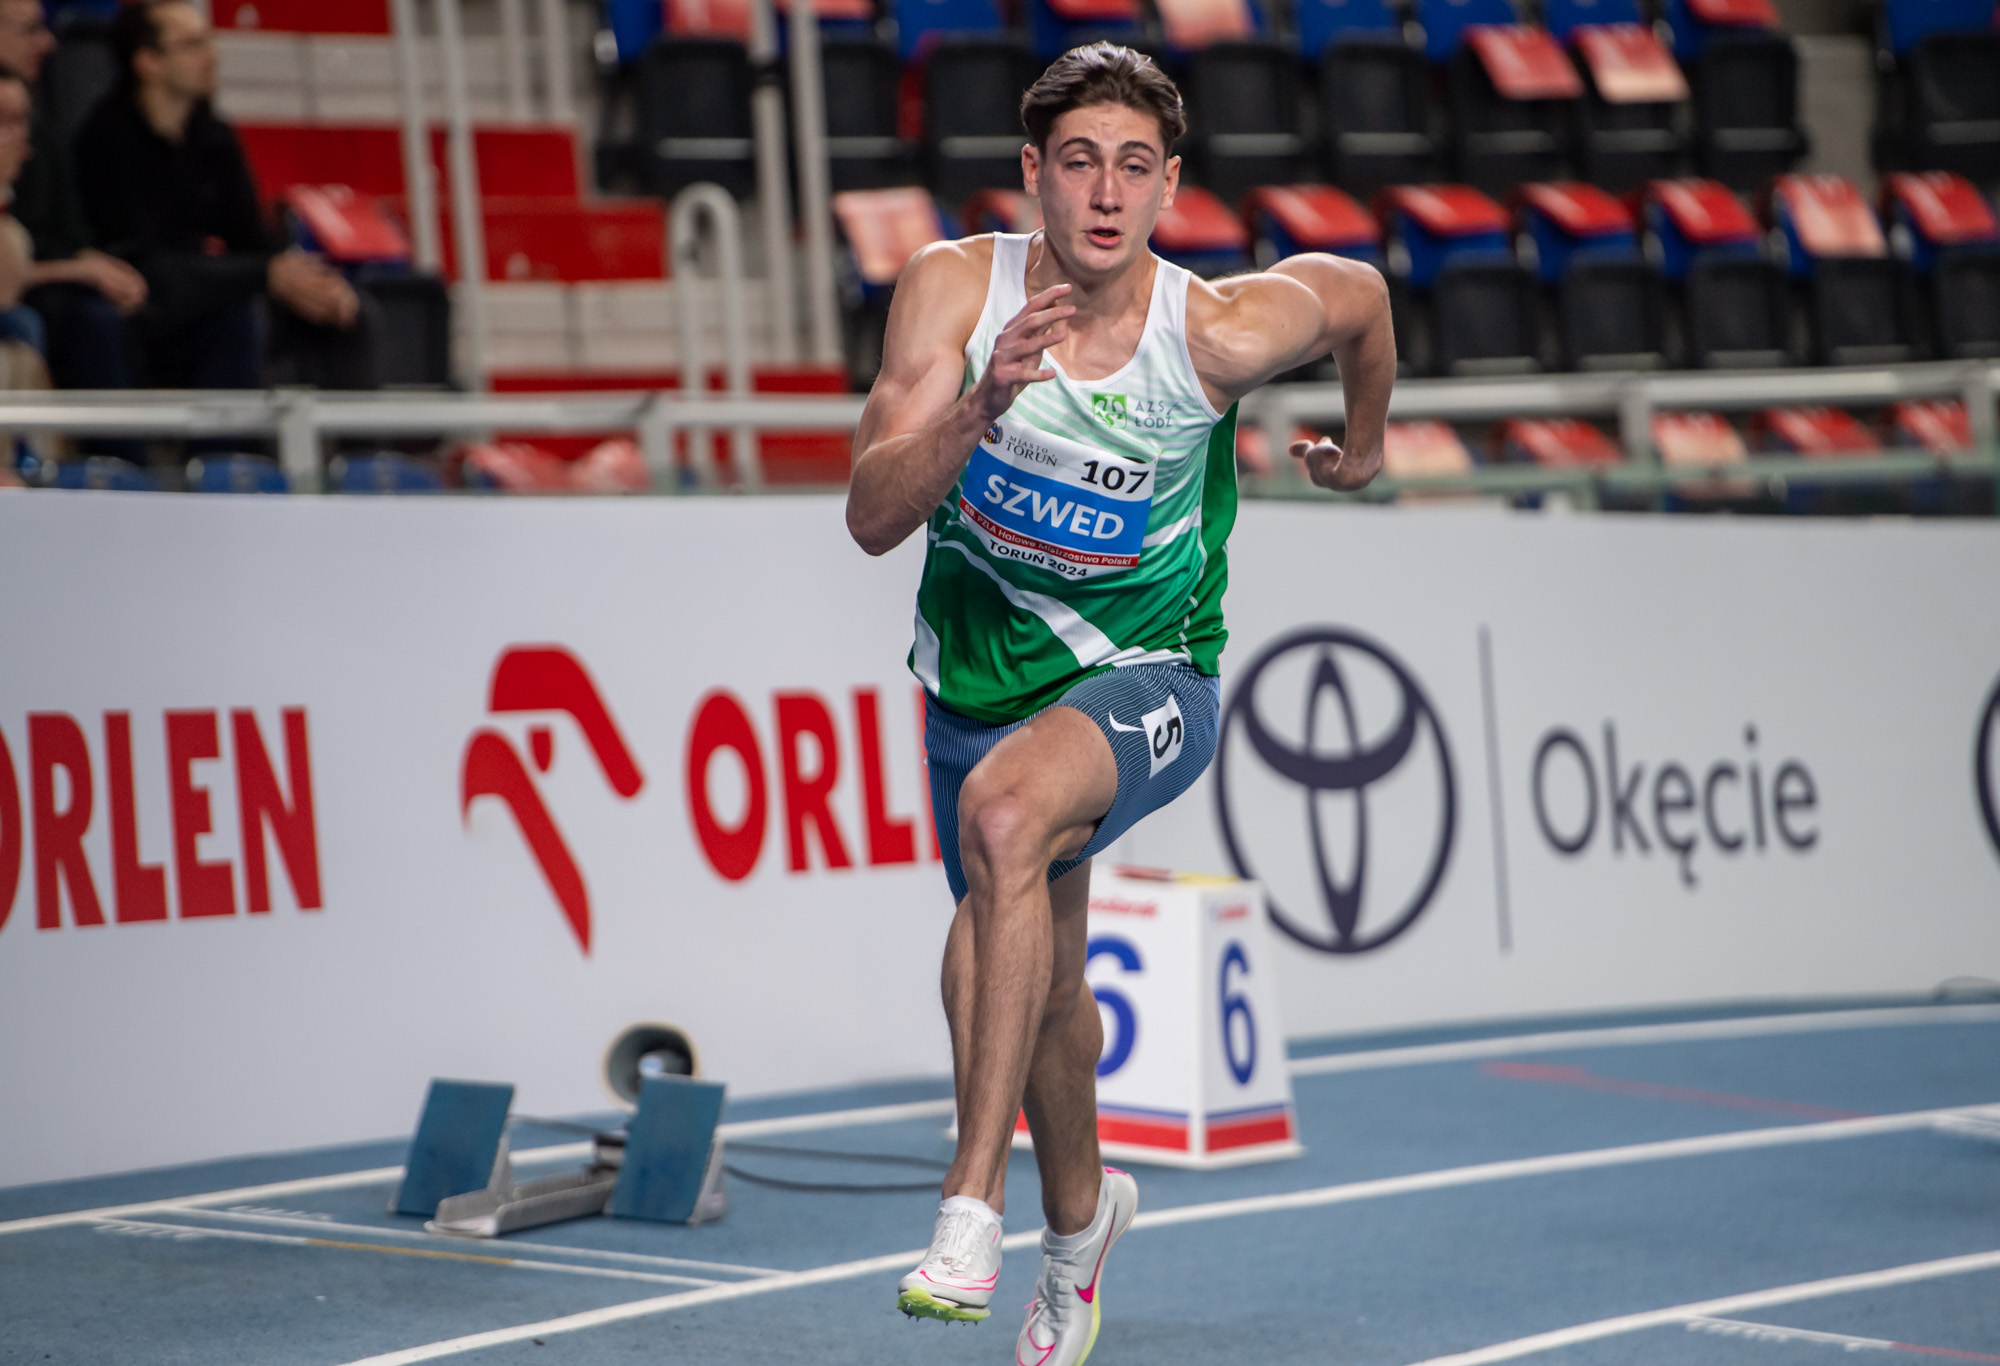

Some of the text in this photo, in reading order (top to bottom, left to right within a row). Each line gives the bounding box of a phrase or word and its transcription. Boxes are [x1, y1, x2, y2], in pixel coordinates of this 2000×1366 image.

[1005, 440, 1058, 467] TORUŃ
[1009, 435, 1049, 454] MIASTO
[1081, 460, 1149, 494] 107
[983, 474, 1125, 540] SZWED
[977, 515, 997, 534] PZLA
[998, 529, 1036, 547] Halowe
[1038, 542, 1099, 563] Mistrzostwa
[1101, 556, 1132, 566] Polski
[990, 539, 1088, 577] TORUŃ 2024
[1153, 716, 1182, 759] 5
[684, 684, 944, 886] ORL
[1532, 719, 1820, 891] Okęcie
[0, 704, 324, 936] RLEN
[1086, 932, 1142, 1078] 6
[1218, 938, 1257, 1086] 6
